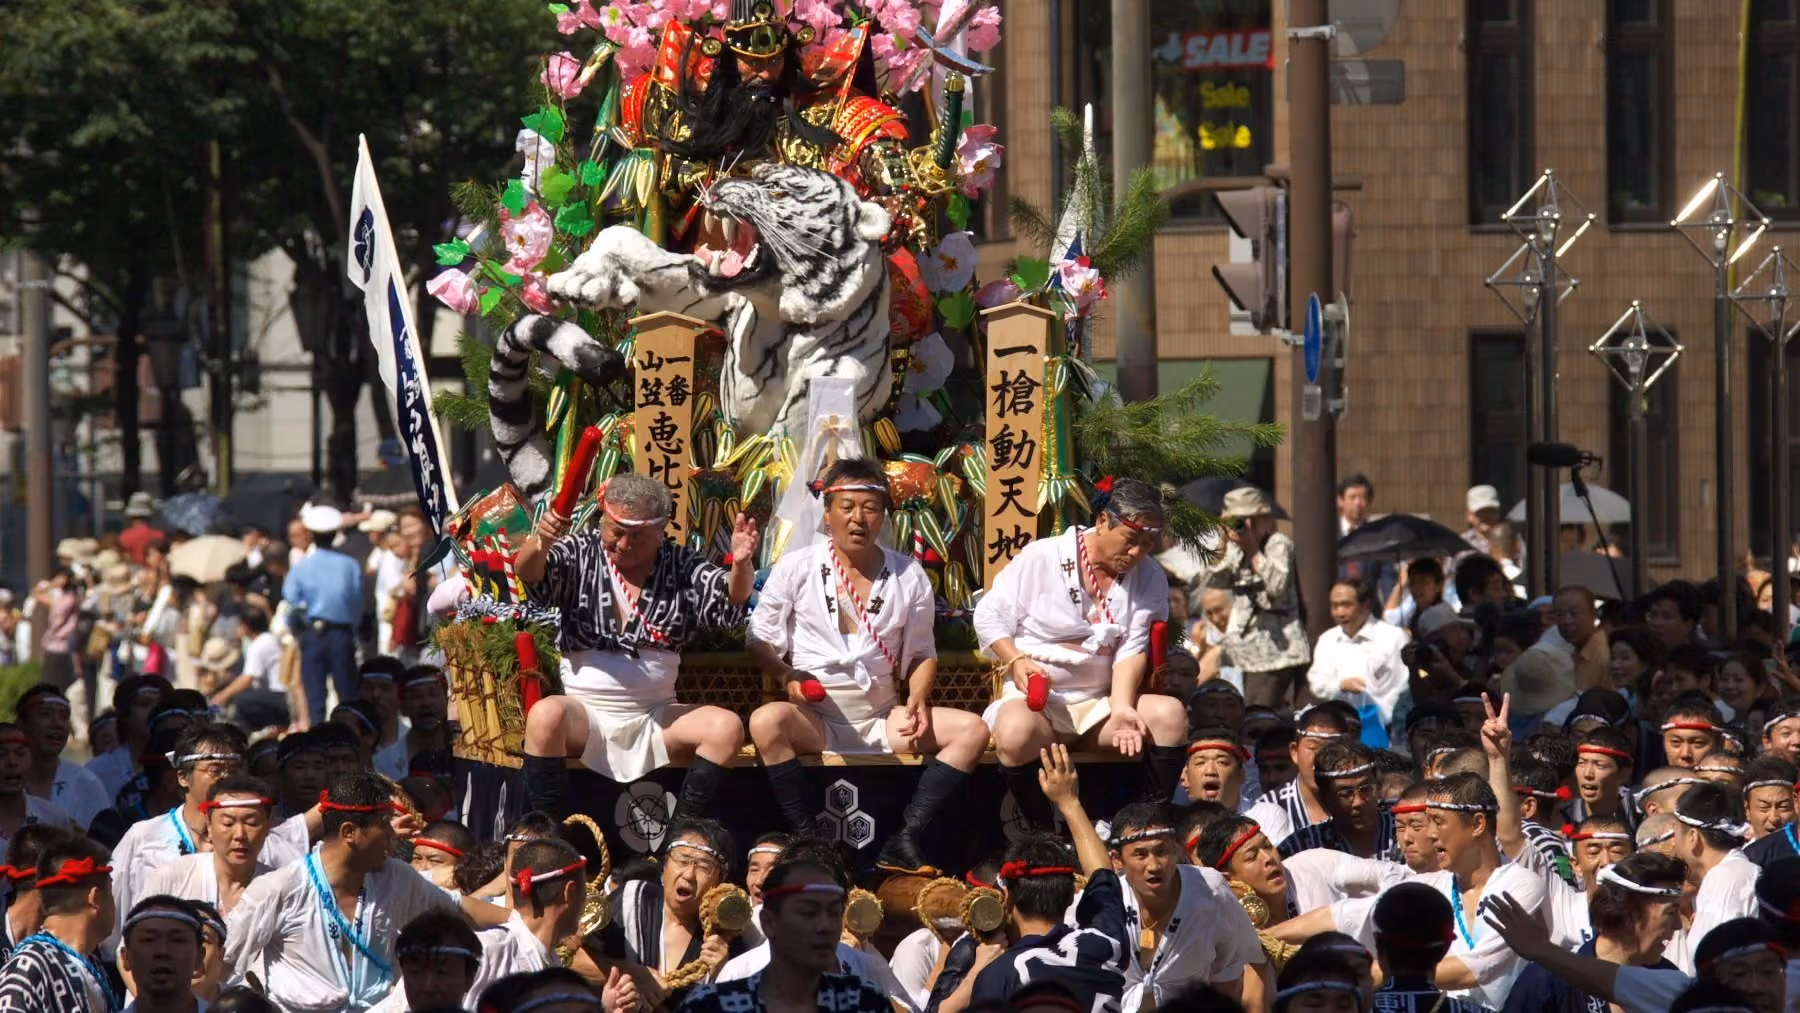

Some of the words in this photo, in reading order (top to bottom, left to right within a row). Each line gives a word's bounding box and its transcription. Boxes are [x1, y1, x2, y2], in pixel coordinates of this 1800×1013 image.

[1185, 32, 1270, 67] SALE
[1201, 81, 1250, 108] Sale
[637, 350, 665, 409] 山笠
[665, 355, 692, 407] 一番
[988, 344, 1042, 565] 一槍動天地
